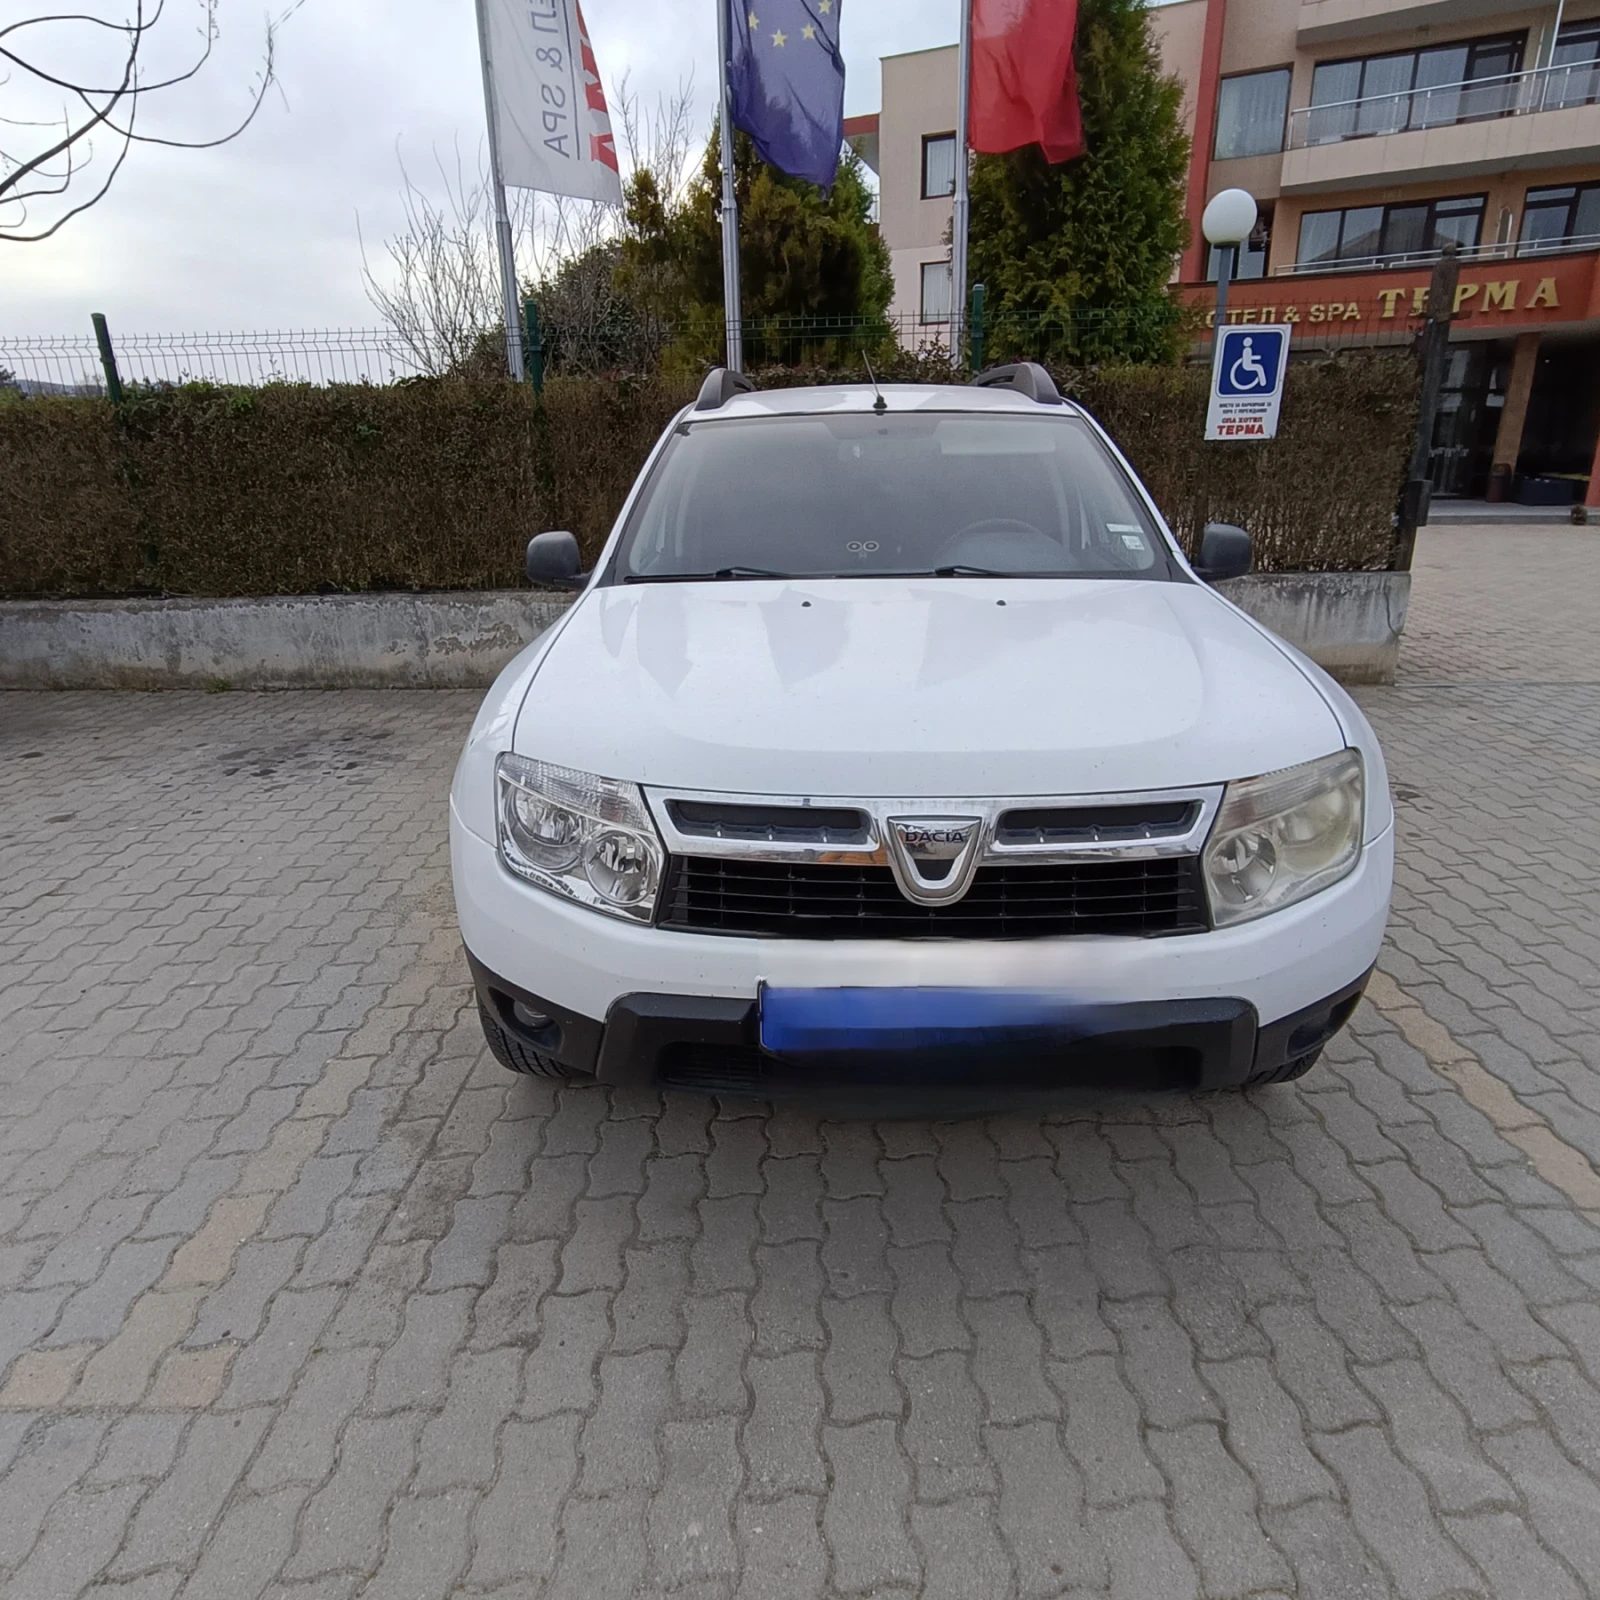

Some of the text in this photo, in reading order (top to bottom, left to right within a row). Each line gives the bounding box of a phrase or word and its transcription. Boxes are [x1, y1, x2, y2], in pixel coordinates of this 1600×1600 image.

[1282, 305, 1300, 323] &
[1309, 302, 1361, 323] SPA
[1217, 424, 1264, 435] ТЕРМА
[905, 831, 964, 842] DACIA
